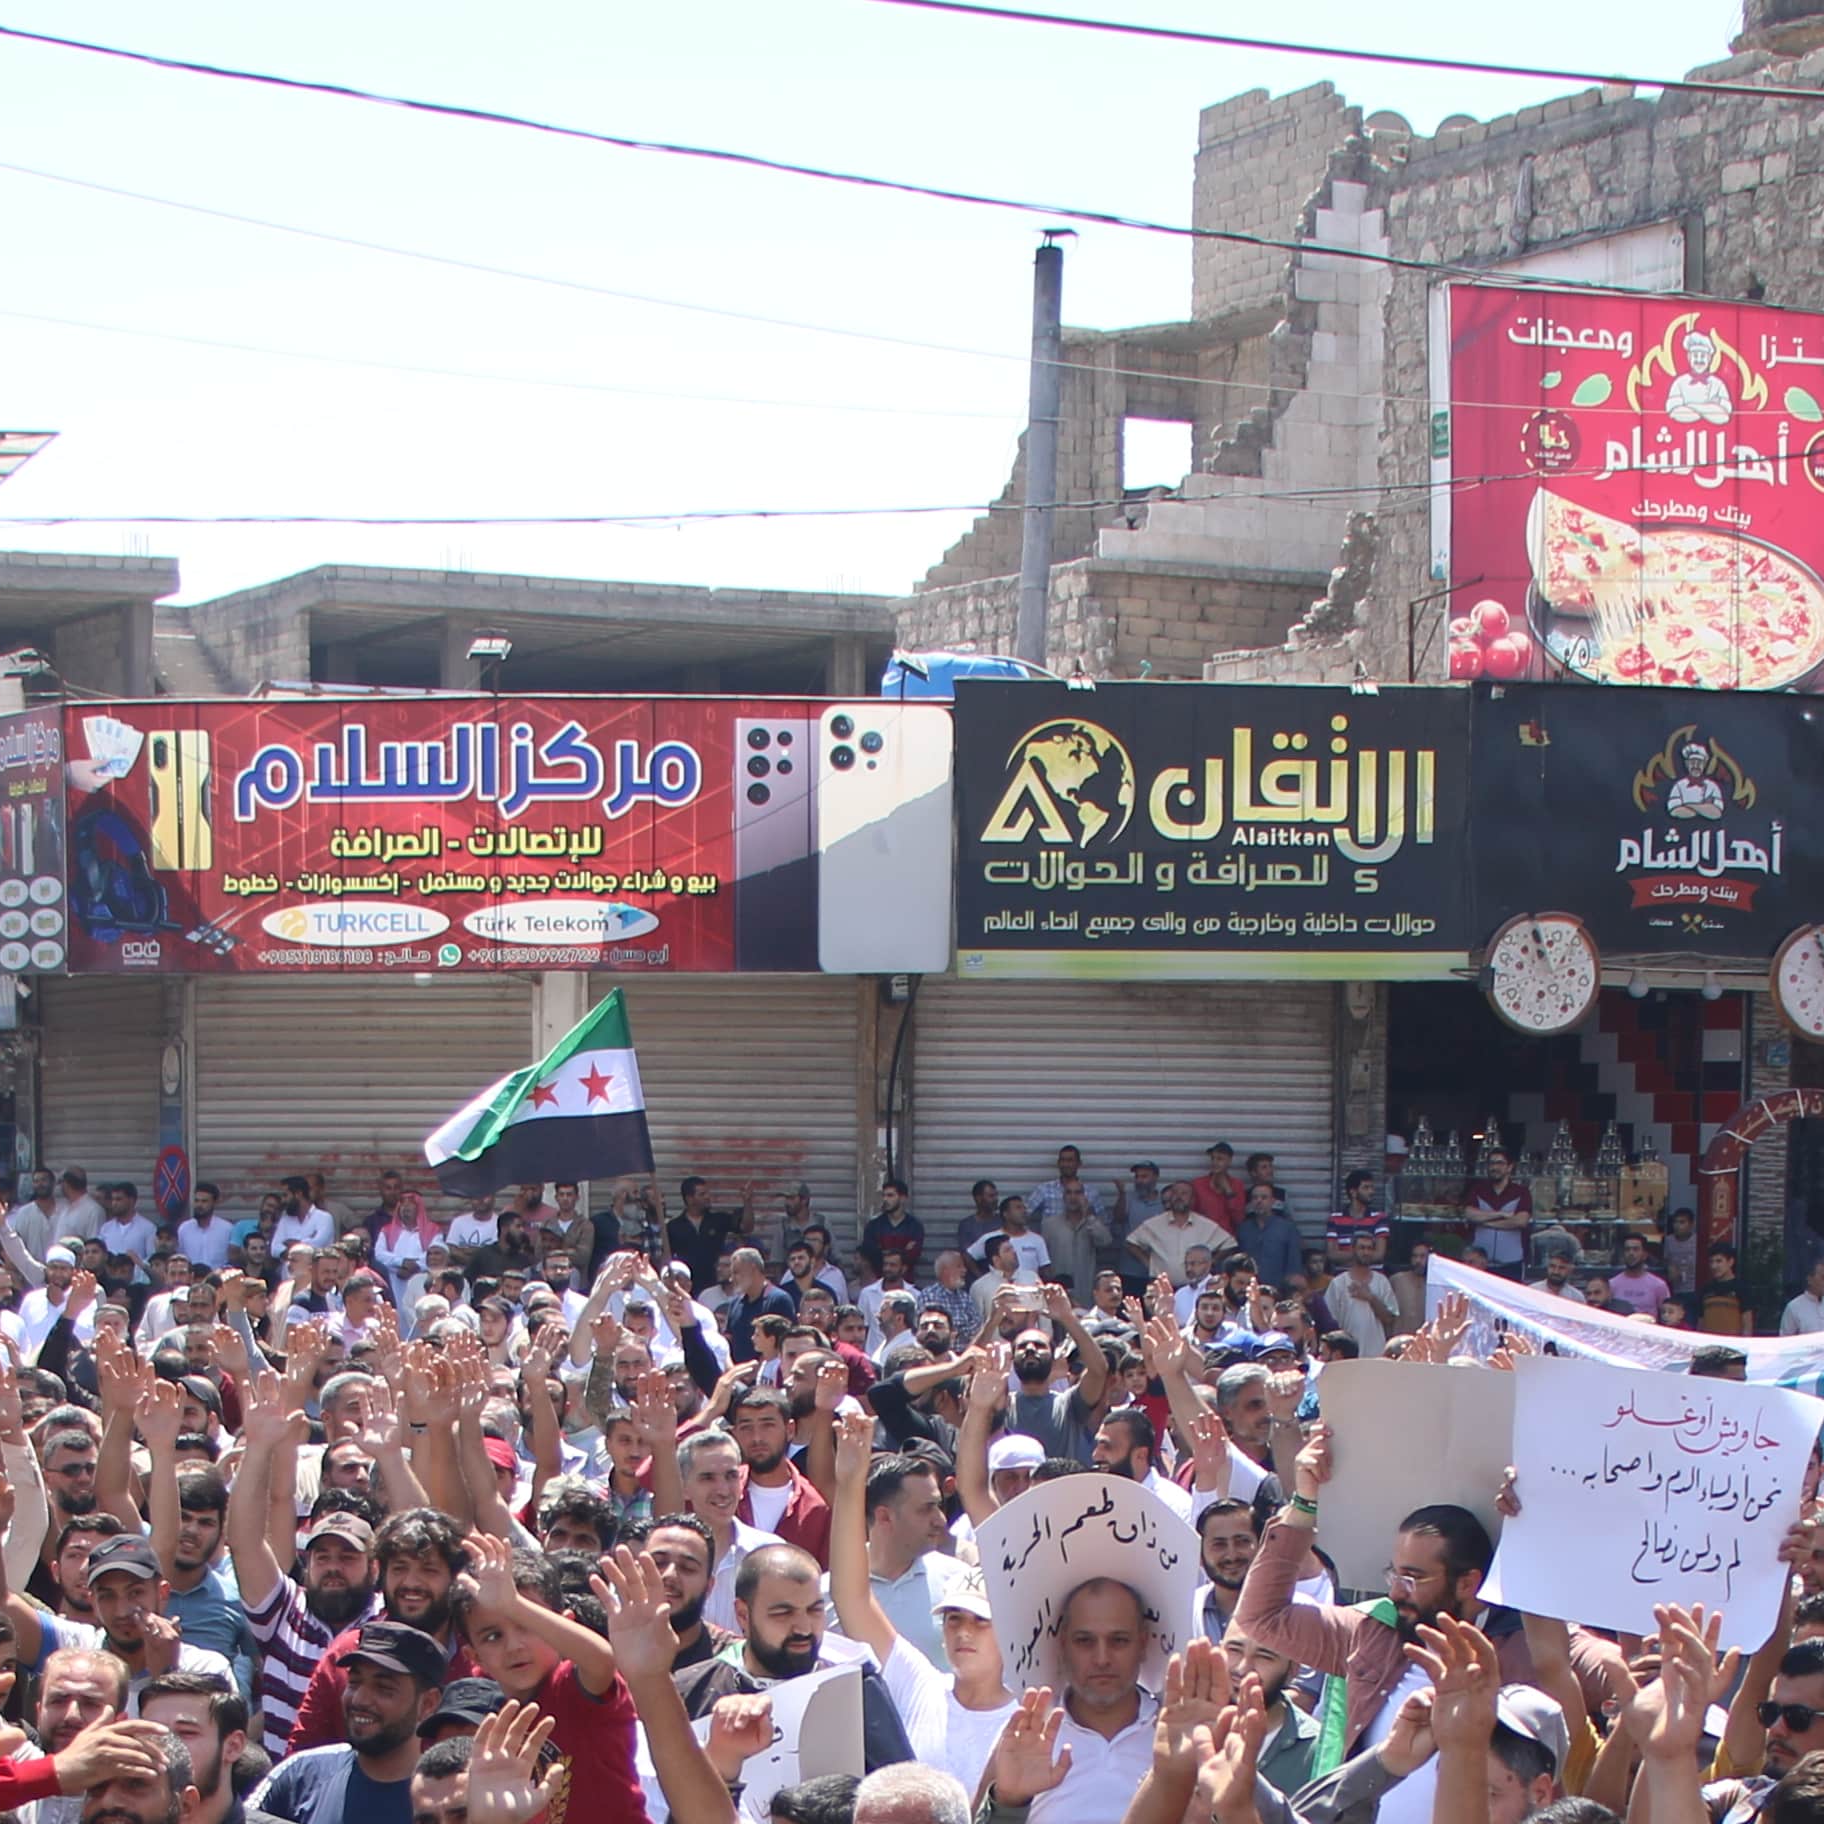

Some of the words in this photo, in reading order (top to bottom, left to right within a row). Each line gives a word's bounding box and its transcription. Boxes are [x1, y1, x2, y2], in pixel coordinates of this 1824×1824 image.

[1507, 316, 1634, 357] ومعجنات
[1594, 426, 1708, 482] الشام
[1697, 420, 1790, 490] أهل
[1631, 499, 1709, 524] ومطرحك
[1712, 503, 1753, 529] بيتك
[233, 721, 499, 822] السلام
[498, 719, 702, 821] مركز
[1148, 713, 1436, 893] الإتقان
[329, 826, 440, 859] الصرافة
[467, 825, 603, 864] للإتصالات
[1231, 826, 1330, 848] Alaitkan
[1615, 827, 1710, 874] الشام
[1696, 819, 1784, 878] أهل
[222, 871, 279, 893] خطوط
[297, 871, 401, 894] إكسسوارات
[489, 877, 500, 893] و
[506, 873, 551, 893] جديد
[554, 871, 617, 893] جوالات
[622, 871, 666, 893] شراء
[670, 878, 681, 893] و
[688, 873, 717, 896] بيع
[983, 850, 1145, 891] الحوالات
[1155, 860, 1176, 892] و
[1186, 850, 1329, 892] للصرافة
[1650, 882, 1709, 904] ومطرحك
[1709, 883, 1740, 902] بيتك
[313, 912, 430, 934] TURKCELL
[473, 914, 517, 933] Türk
[523, 915, 610, 933] Telekom
[982, 908, 1035, 934] العالم
[1084, 911, 1136, 939] جميع
[1192, 914, 1221, 934] من
[1227, 910, 1298, 936] وخارجية
[1302, 911, 1359, 933] داخلية
[1363, 911, 1437, 936] حوالات
[1600, 1388, 1714, 1437] أوغلو
[1664, 1465, 1701, 1515] الدم
[1742, 1477, 1783, 1522] نحن
[1060, 1486, 1115, 1563] طعم
[1107, 1510, 1158, 1550] ذاق
[1001, 1510, 1053, 1588] الحرية
[1679, 1533, 1722, 1573] ولن
[1725, 1537, 1743, 1602] لم
